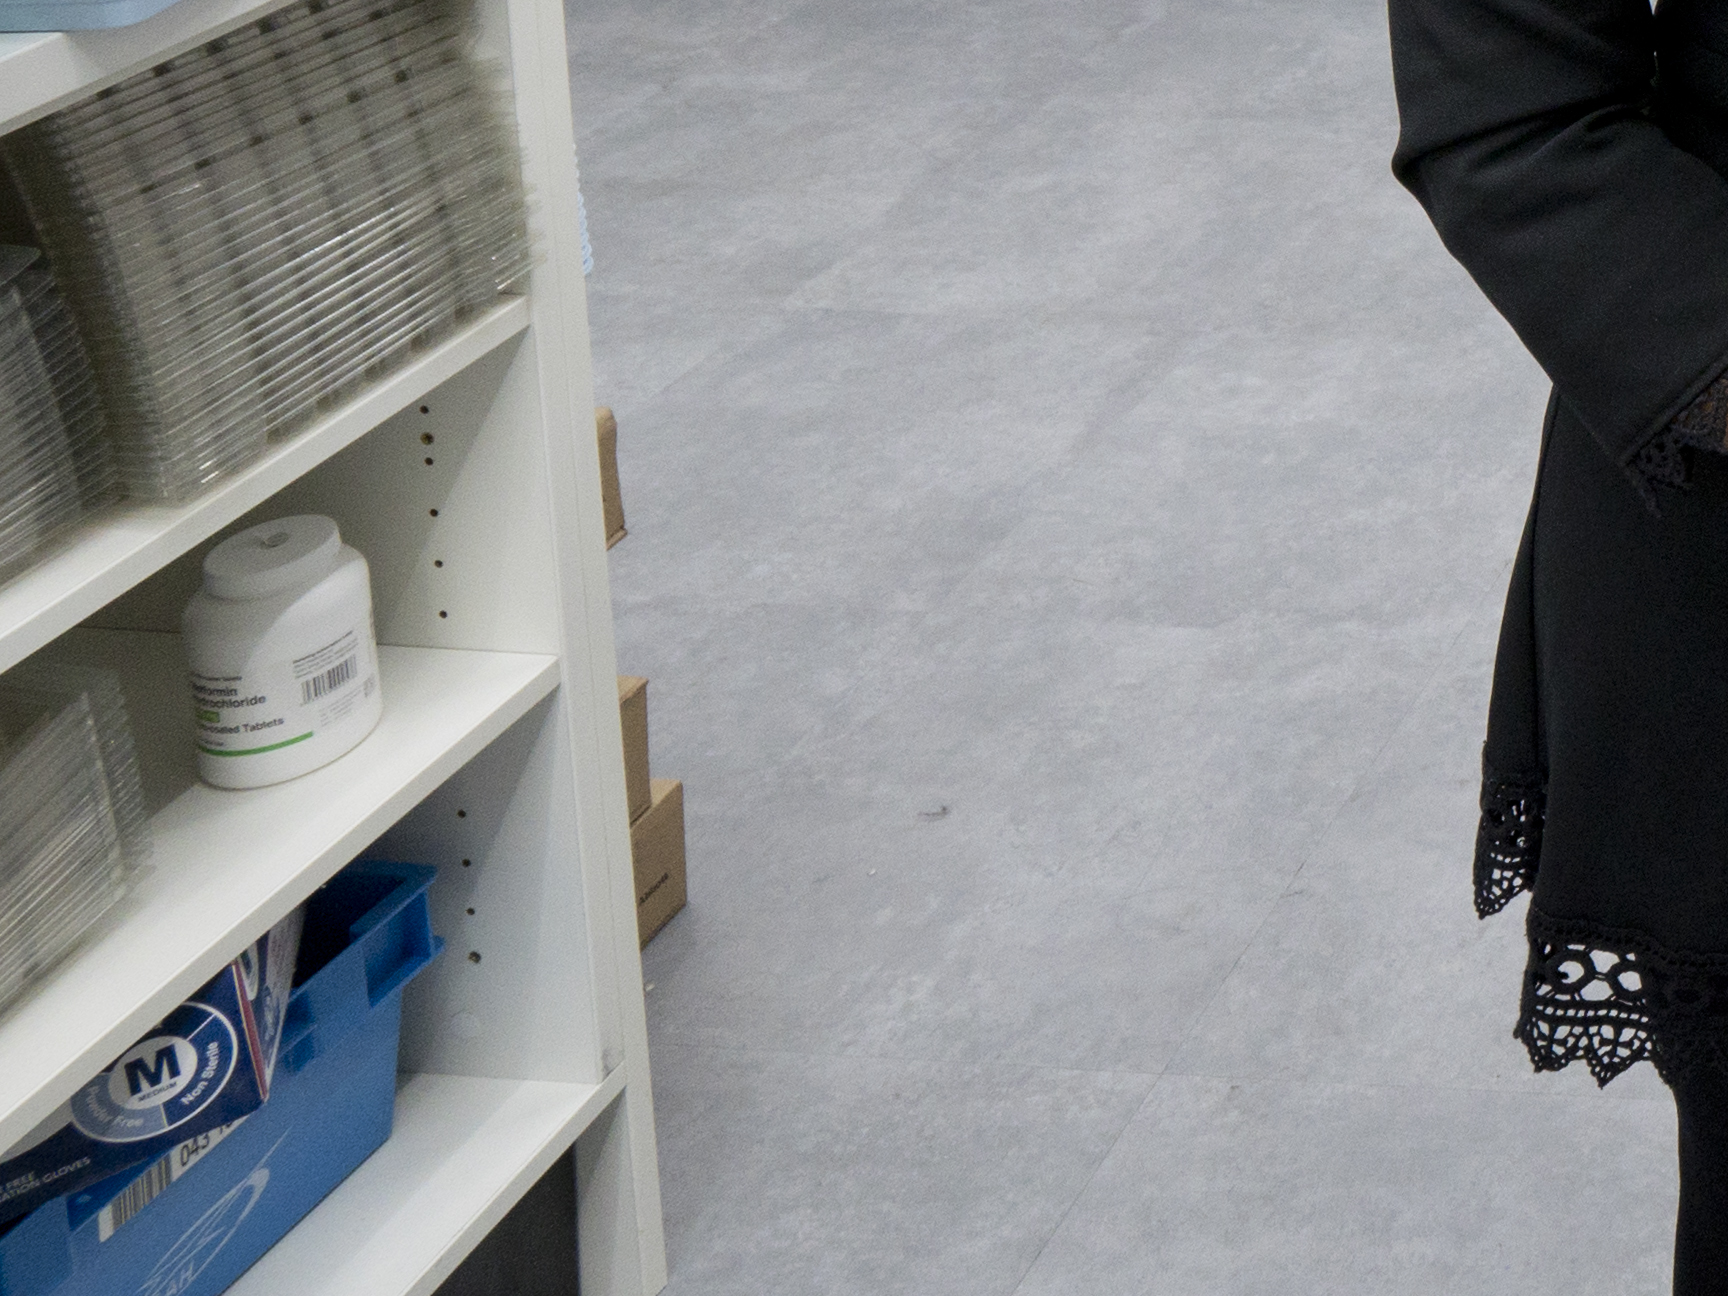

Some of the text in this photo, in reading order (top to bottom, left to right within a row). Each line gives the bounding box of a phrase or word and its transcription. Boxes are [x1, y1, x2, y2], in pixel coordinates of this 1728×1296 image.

[242, 717, 285, 732] Tablets
[124, 1043, 182, 1097] M
[180, 1040, 220, 1106] Non Sterile
[137, 1080, 178, 1104] MEDIUM
[111, 1116, 144, 1129] Free
[179, 1132, 211, 1168] 043
[42, 1156, 92, 1183] GLOVES
